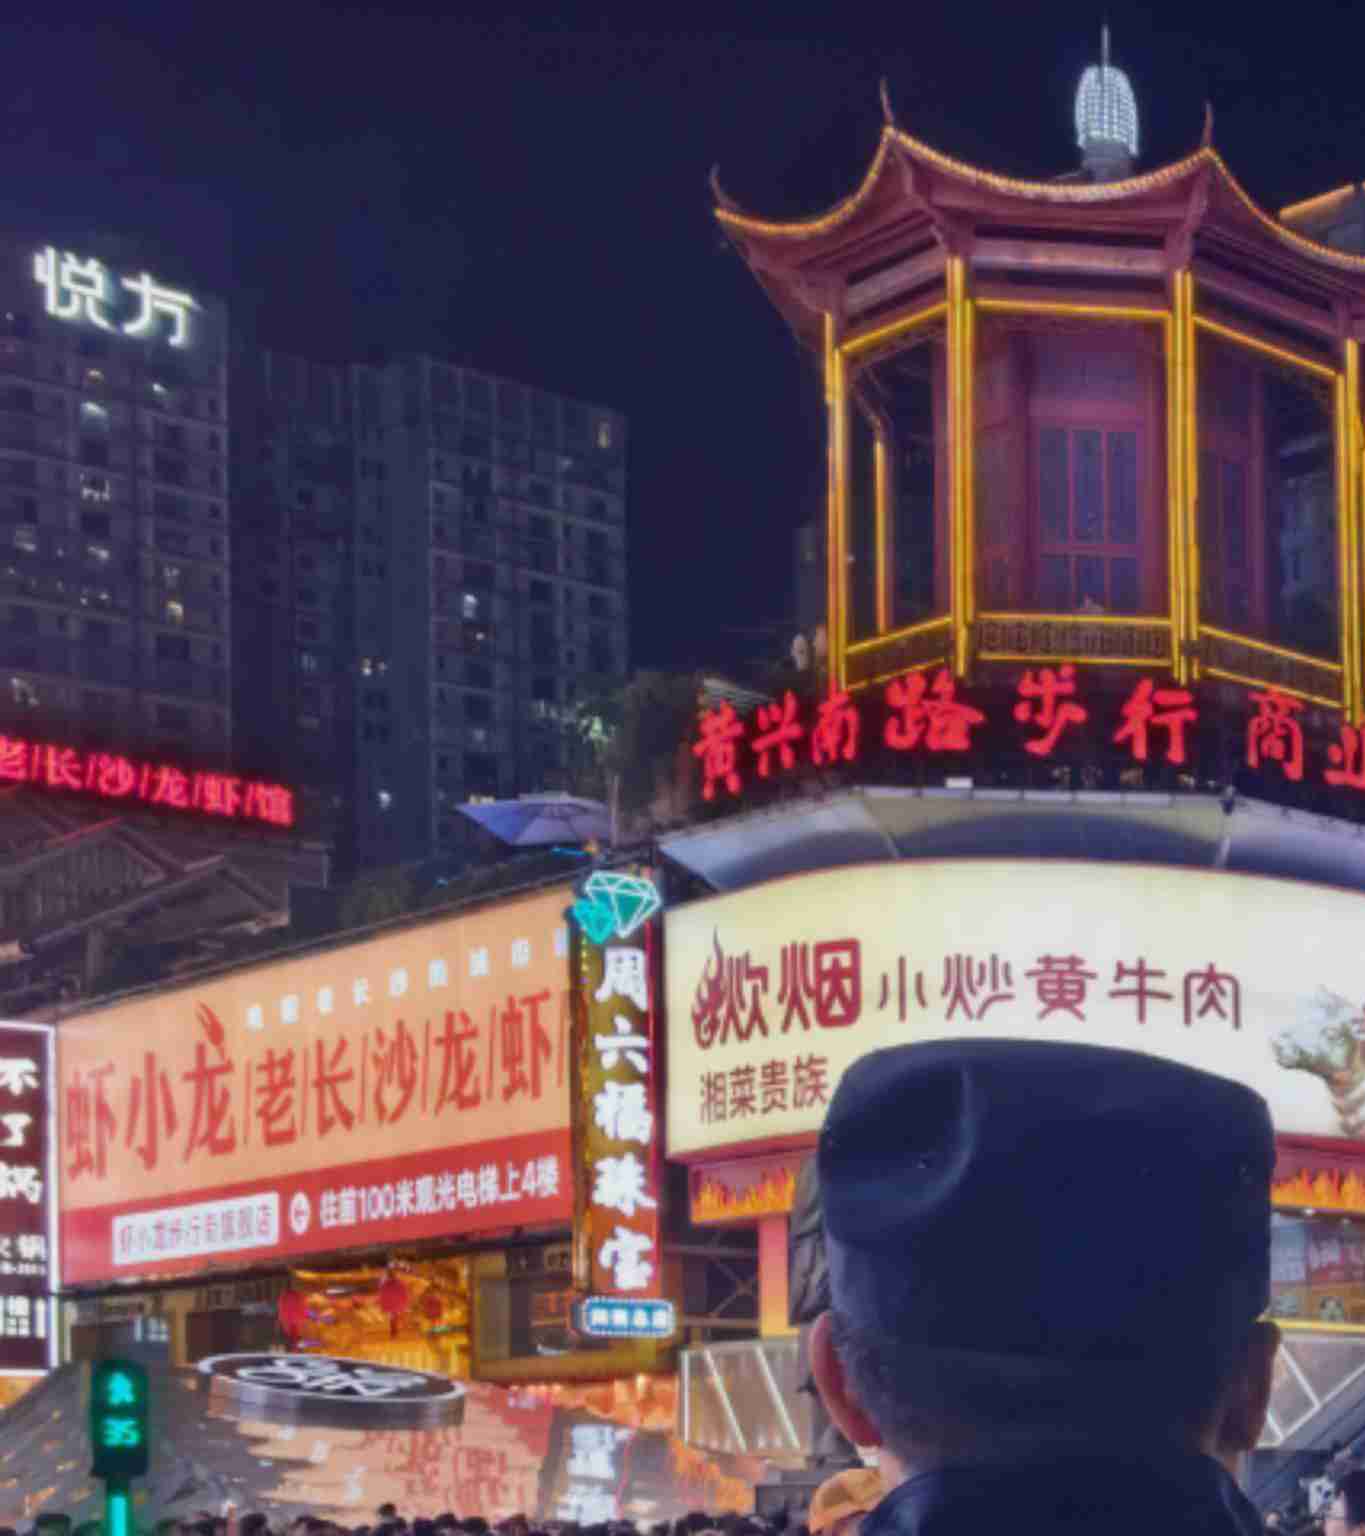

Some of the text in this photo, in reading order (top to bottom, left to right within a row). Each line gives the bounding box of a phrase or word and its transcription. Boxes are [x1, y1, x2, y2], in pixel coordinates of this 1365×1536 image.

[33, 246, 198, 347] 悦方
[593, 946, 656, 1291] 周六福珠宝
[698, 1054, 831, 1125] 湘菜贵族
